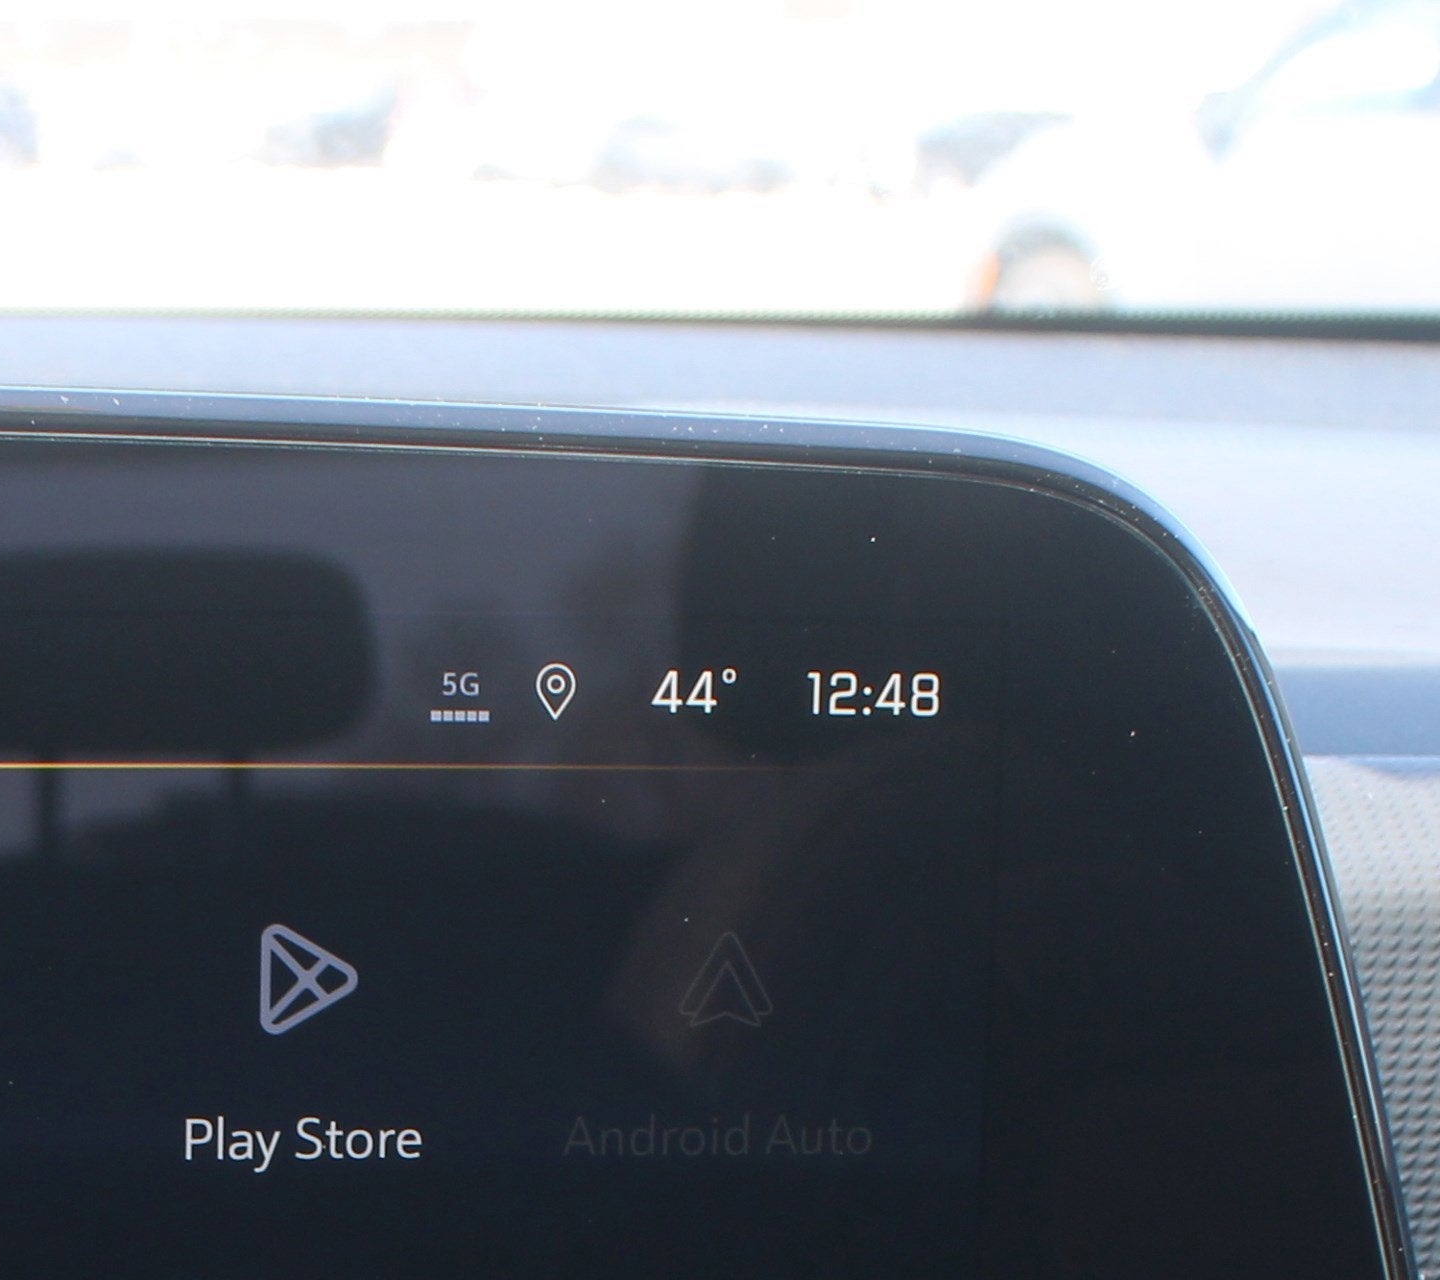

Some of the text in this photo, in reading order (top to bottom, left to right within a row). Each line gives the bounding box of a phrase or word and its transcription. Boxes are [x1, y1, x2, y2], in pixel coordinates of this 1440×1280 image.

[441, 670, 481, 698] 5G
[650, 667, 738, 715] 44°
[806, 669, 941, 718] 12:48
[183, 1114, 424, 1175] Play Store
[563, 1113, 872, 1156] Android Auto
